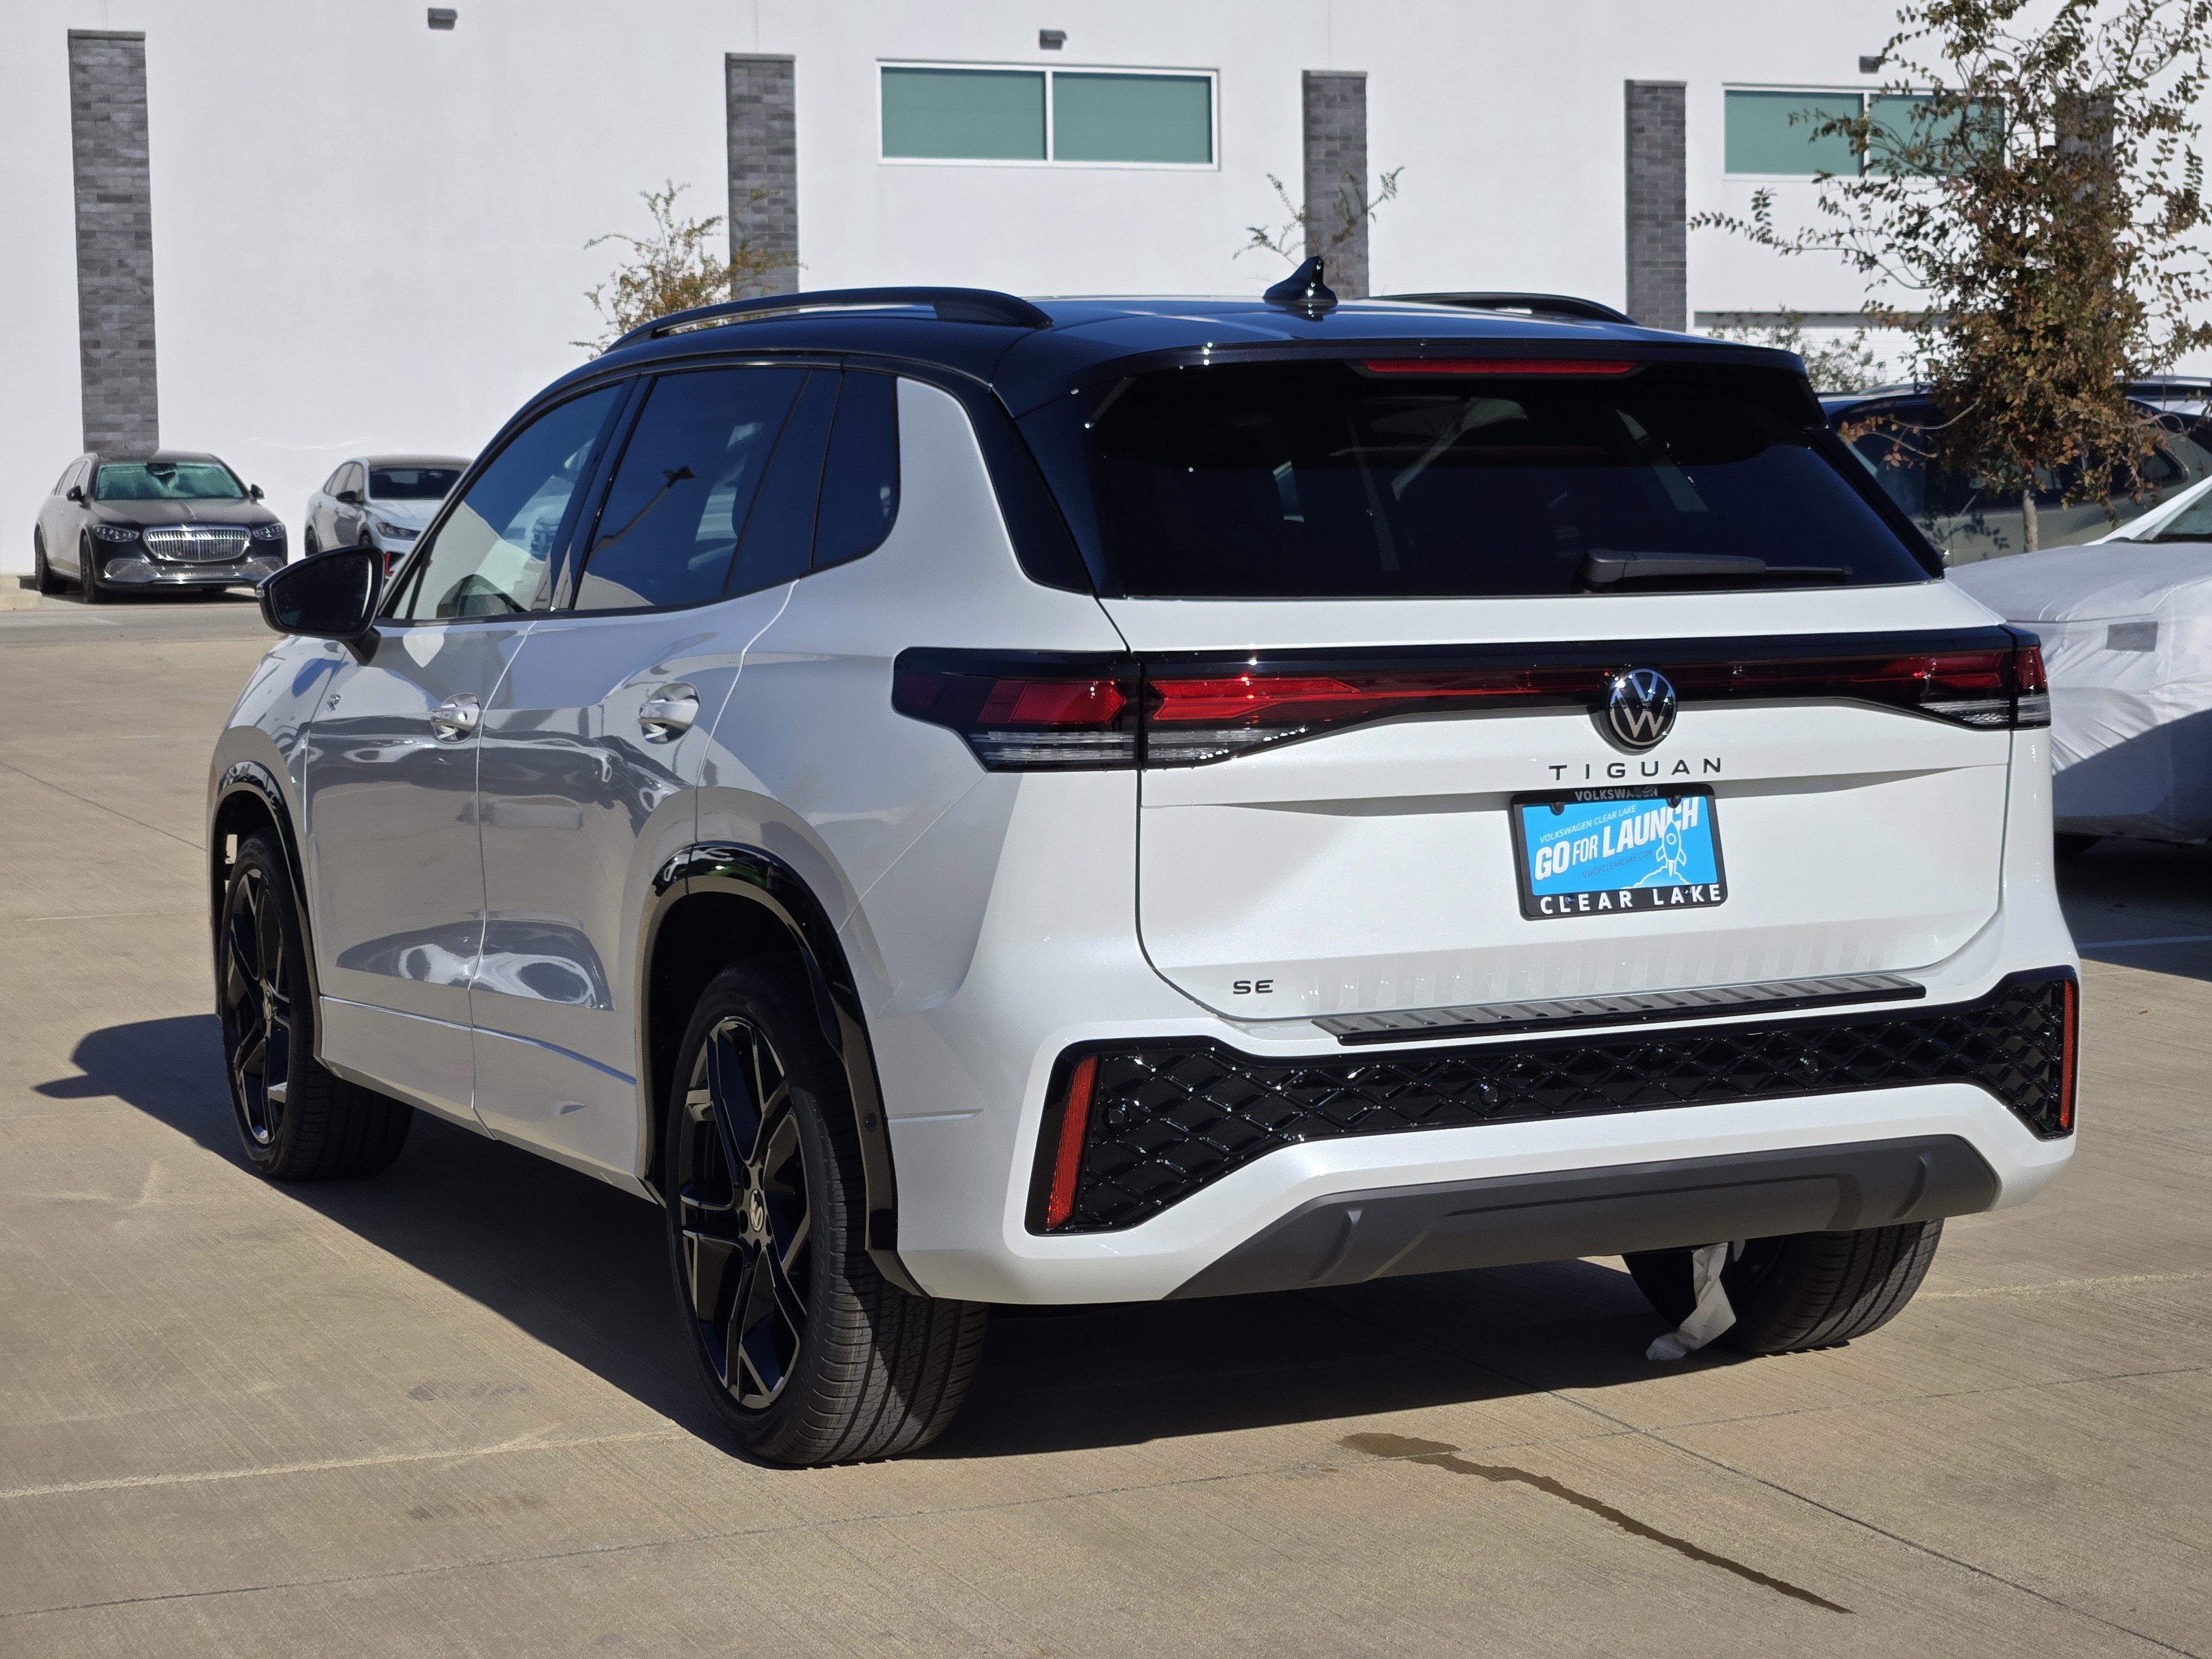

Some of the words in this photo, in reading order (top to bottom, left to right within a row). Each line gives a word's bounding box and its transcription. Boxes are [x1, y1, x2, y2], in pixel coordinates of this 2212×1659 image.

[1548, 758, 1721, 781] TIGUAN
[1574, 787, 1658, 801] VOLKSWAN
[1535, 841, 1570, 880] GO
[1572, 834, 1598, 865] FOR
[1602, 796, 1699, 858] LAUNCH
[1540, 819, 1592, 843] VOLKSWAGEN
[1594, 811, 1616, 825] CLEAR
[1618, 805, 1637, 817] LAKE
[1582, 849, 1652, 878] VWOFCLEARLAKE.COM
[1540, 891, 1632, 914] CLEAR
[1653, 884, 1721, 906] LAKE
[1233, 979, 1274, 994] SE
